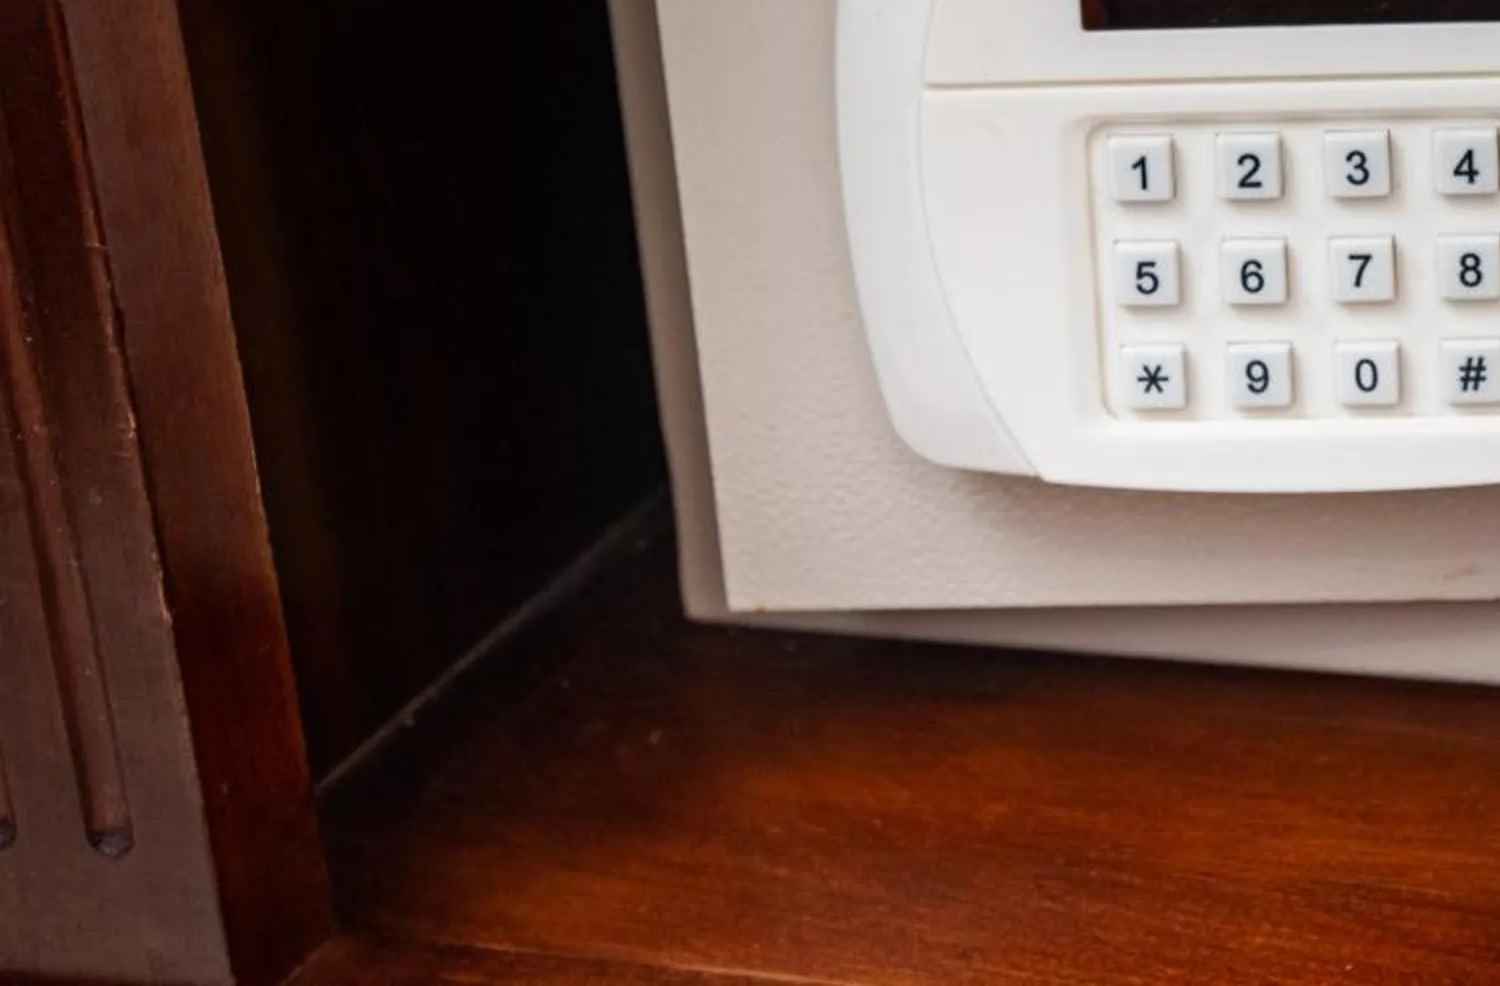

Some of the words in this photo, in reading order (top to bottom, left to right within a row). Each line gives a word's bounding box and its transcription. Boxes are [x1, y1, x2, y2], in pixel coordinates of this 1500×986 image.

[1130, 155, 1149, 191] 1
[1237, 153, 1263, 189] 2
[1345, 149, 1371, 186] 3
[1452, 148, 1480, 185] 4
[1135, 261, 1160, 295] 5
[1240, 259, 1265, 294] 6
[1348, 253, 1373, 288] 7
[1459, 252, 1483, 288] 8
[1245, 359, 1270, 394] 9
[1355, 358, 1379, 393] 0
[1459, 356, 1487, 392] #
